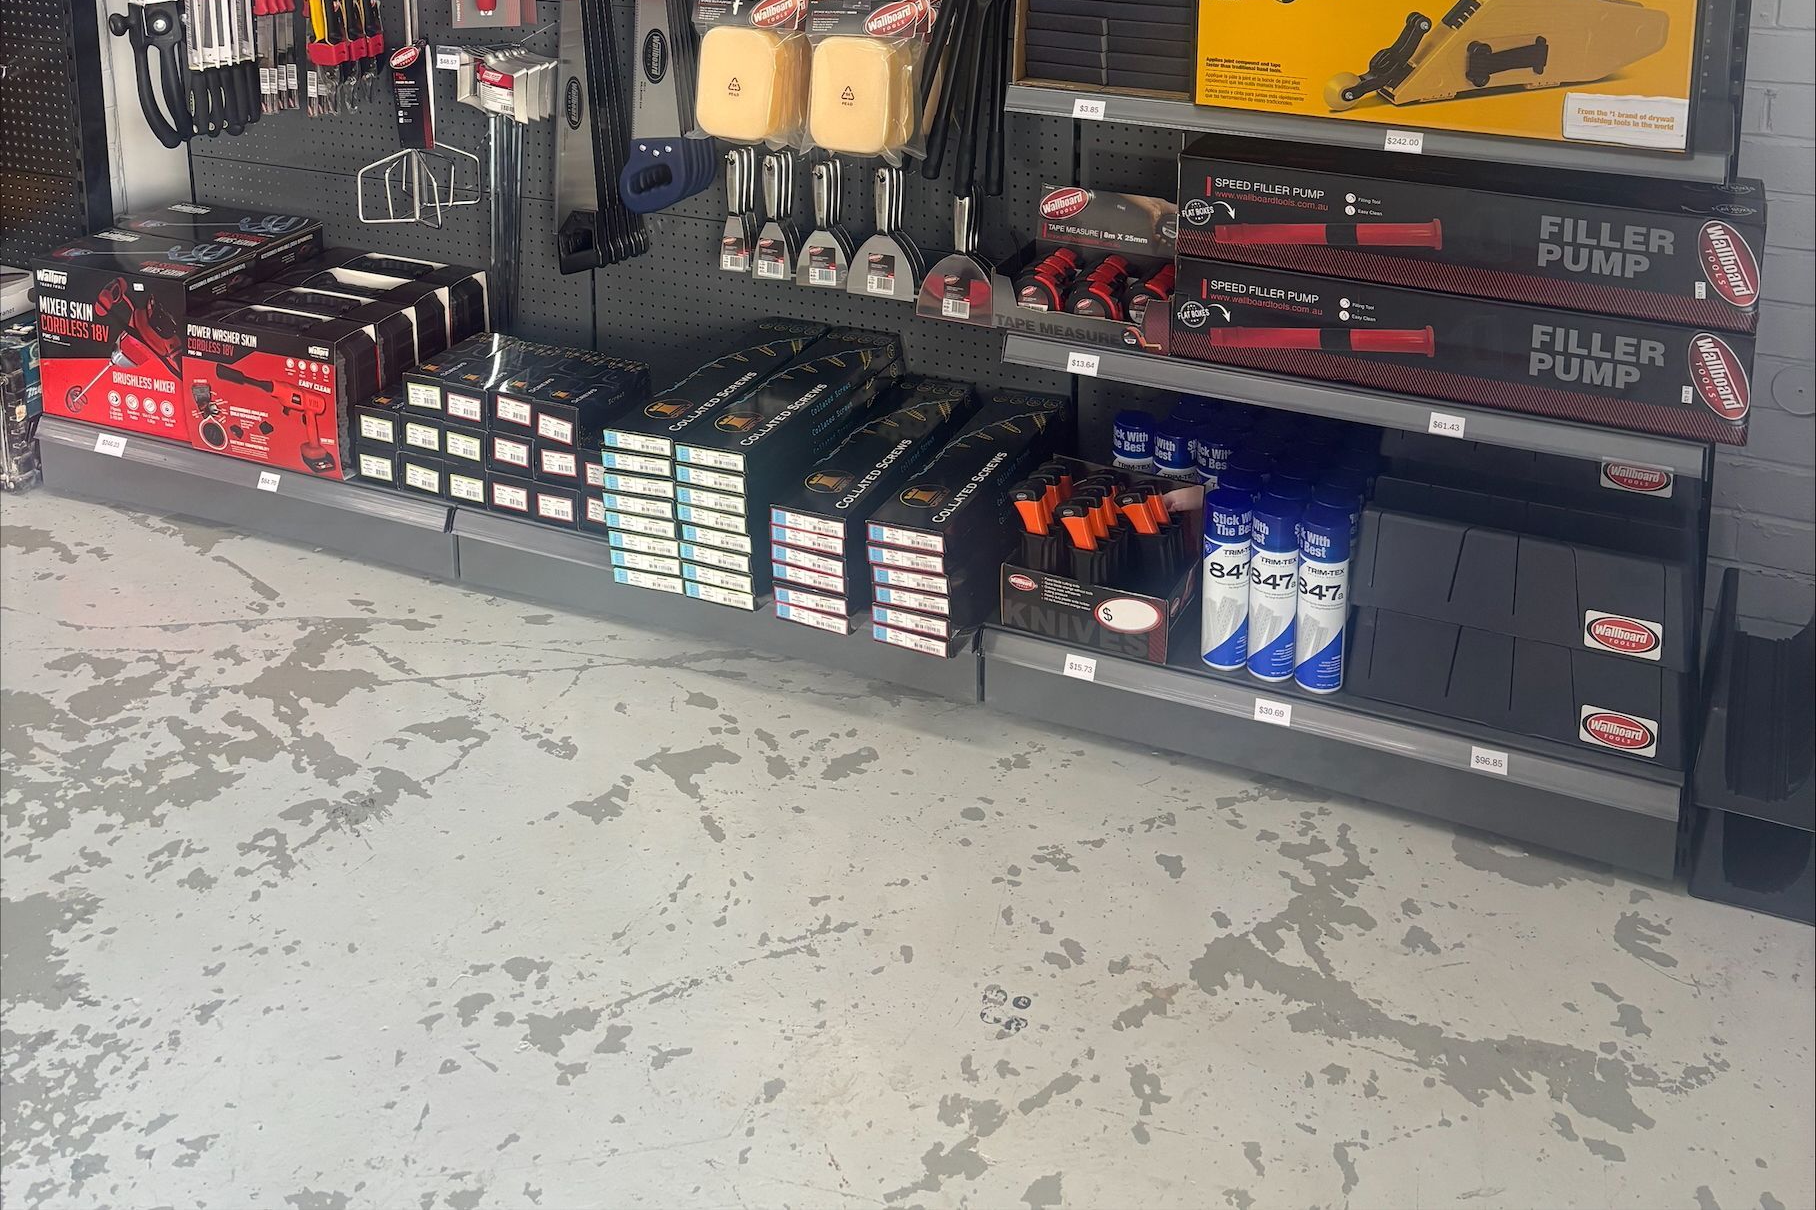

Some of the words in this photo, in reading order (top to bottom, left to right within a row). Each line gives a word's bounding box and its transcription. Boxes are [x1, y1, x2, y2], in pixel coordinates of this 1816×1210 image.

[867, 4, 912, 31] Wallboard
[652, 35, 661, 76] Wallboard
[1080, 105, 1099, 113] $3.85
[1578, 108, 1595, 116] From
[1618, 112, 1638, 120] brand
[1648, 114, 1674, 123] drywall
[1583, 116, 1612, 125] finishing
[1614, 118, 1631, 126] tools
[1654, 122, 1674, 130] world
[1387, 136, 1420, 148] $242.00
[1215, 177, 1251, 191] SPEED
[1253, 182, 1290, 196] FILLER
[1292, 187, 1325, 200] PUMP
[1042, 191, 1083, 214] Wallboard
[1214, 190, 1329, 211] www.wallboardtools.com.au
[1181, 206, 1195, 218] FLAT
[1048, 223, 1065, 234] TAPE
[1065, 226, 1099, 239] MEASURE
[1124, 234, 1148, 244] 25mm
[1540, 215, 1675, 255] FILLER
[1536, 242, 1651, 278] PUMP
[1706, 225, 1754, 298] Wallboard
[37, 269, 68, 285] Wallpro
[1210, 280, 1247, 294] SPEED
[1249, 285, 1285, 300] FILLER
[1287, 291, 1320, 304] PUMP
[39, 295, 69, 318] MIXER
[70, 301, 92, 322] SKIN
[1177, 309, 1191, 320] FLAT
[1210, 293, 1324, 316] www.wallboardtools.com.au
[41, 314, 88, 339] CORDLESS
[91, 324, 109, 343] 18V
[187, 323, 211, 341] POWER
[212, 328, 241, 345] WASHER
[242, 333, 257, 348] SKIN
[994, 313, 1036, 332] TAPE
[1039, 322, 1121, 345] MEASURE
[188, 337, 220, 354] CORDLESS
[222, 344, 234, 357] 18V
[1531, 324, 1665, 367] FILLER
[1071, 359, 1095, 369] $13.64
[1528, 351, 1641, 389] PUMP
[1697, 338, 1744, 411] Wallboard
[112, 371, 152, 390] BRUSHLESS
[153, 379, 175, 394] MIXER
[298, 379, 312, 390] EASY
[313, 384, 332, 394] CLEAN
[668, 394, 721, 432] COLLATED
[717, 370, 758, 399] SCREWS
[740, 405, 793, 447] COLLATED
[788, 381, 828, 412] SCREWS
[1432, 420, 1460, 431] $61.43
[1123, 440, 1146, 452] Best
[1126, 431, 1149, 443] With
[835, 469, 882, 510] COLLATED
[876, 439, 912, 469] SCREWS
[1609, 462, 1661, 485] Wallboard
[932, 482, 978, 523] COLLATED
[971, 451, 1008, 482] SCREWS
[1212, 511, 1240, 526] Stick
[1216, 523, 1236, 536] The
[1306, 531, 1331, 548] With
[1260, 556, 1297, 566] TRIM-TEX
[1304, 543, 1327, 559] Best
[1307, 566, 1345, 576] TRIM-TEX
[1102, 607, 1113, 622] $
[1594, 623, 1648, 645] Wallboard
[1608, 637, 1637, 649] TOOLS
[1069, 662, 1093, 674] $15.73
[1259, 705, 1285, 718] $30.69
[1590, 719, 1643, 742] Wallboard
[1603, 733, 1632, 744] TOOLS
[1474, 754, 1503, 768] $96.85
